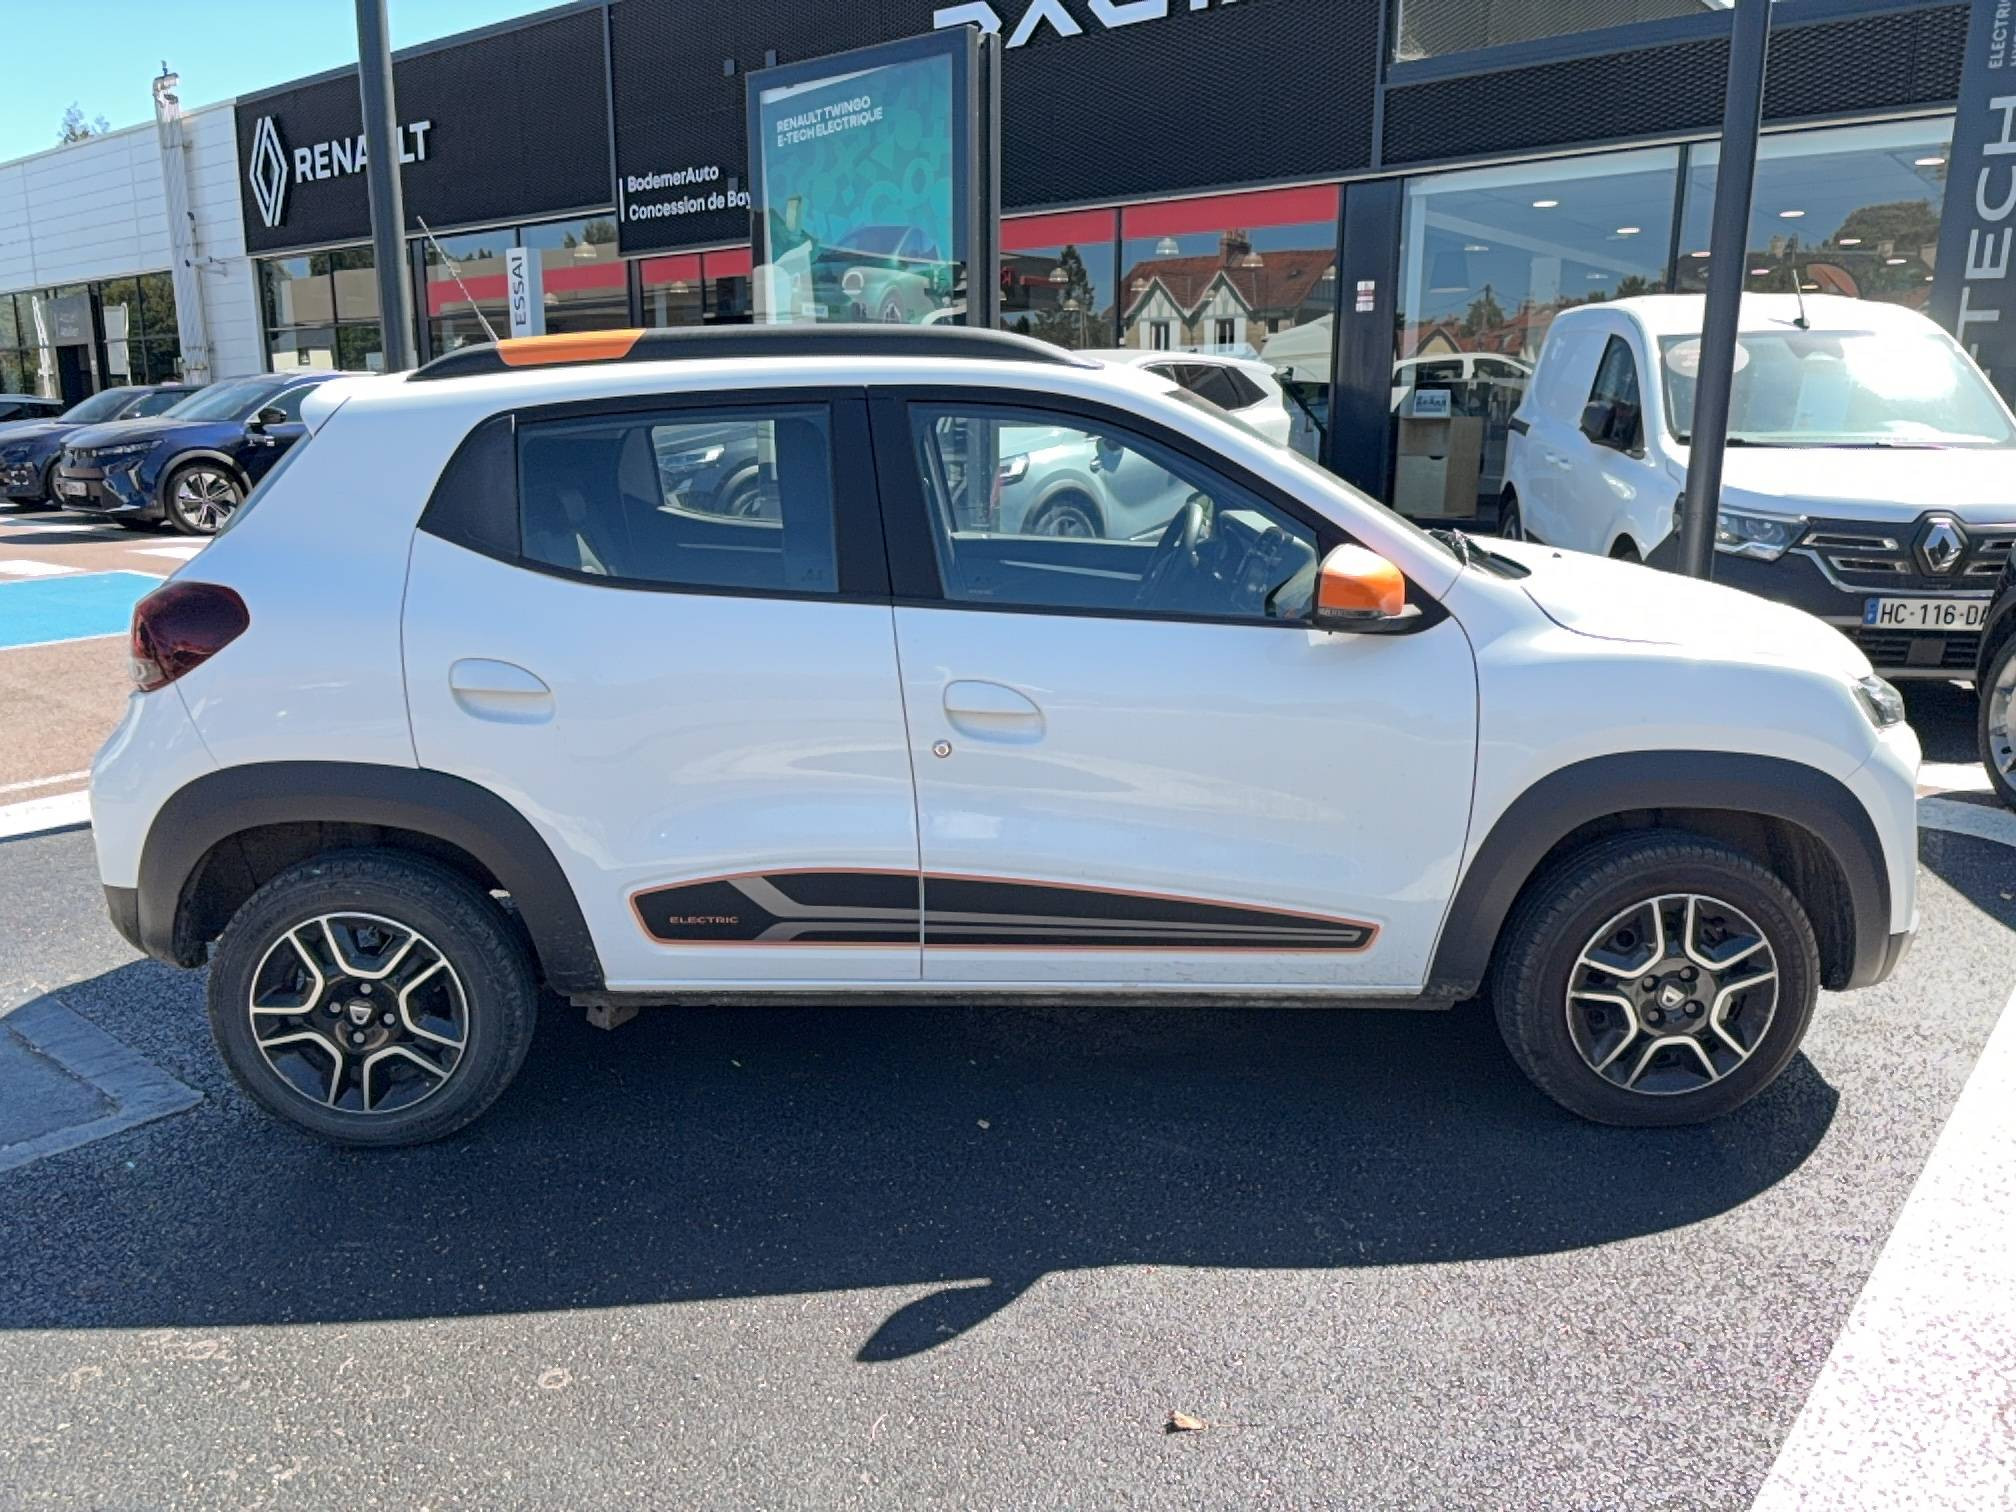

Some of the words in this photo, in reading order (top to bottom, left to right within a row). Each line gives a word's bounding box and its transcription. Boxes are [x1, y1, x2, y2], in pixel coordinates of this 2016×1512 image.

[1988, 0, 2011, 69] ELECTRI
[776, 109, 822, 133] RENAULT
[824, 95, 871, 119] TWINGO
[777, 127, 815, 147] E-TECH
[815, 106, 883, 136] ELECTRIQUE
[294, 120, 431, 184] RENALT
[627, 166, 719, 193] BodemerAuto
[629, 196, 705, 221] Concession
[707, 192, 725, 211] de
[512, 256, 526, 327] ESSAI
[669, 915, 739, 924] ELECTRIC
